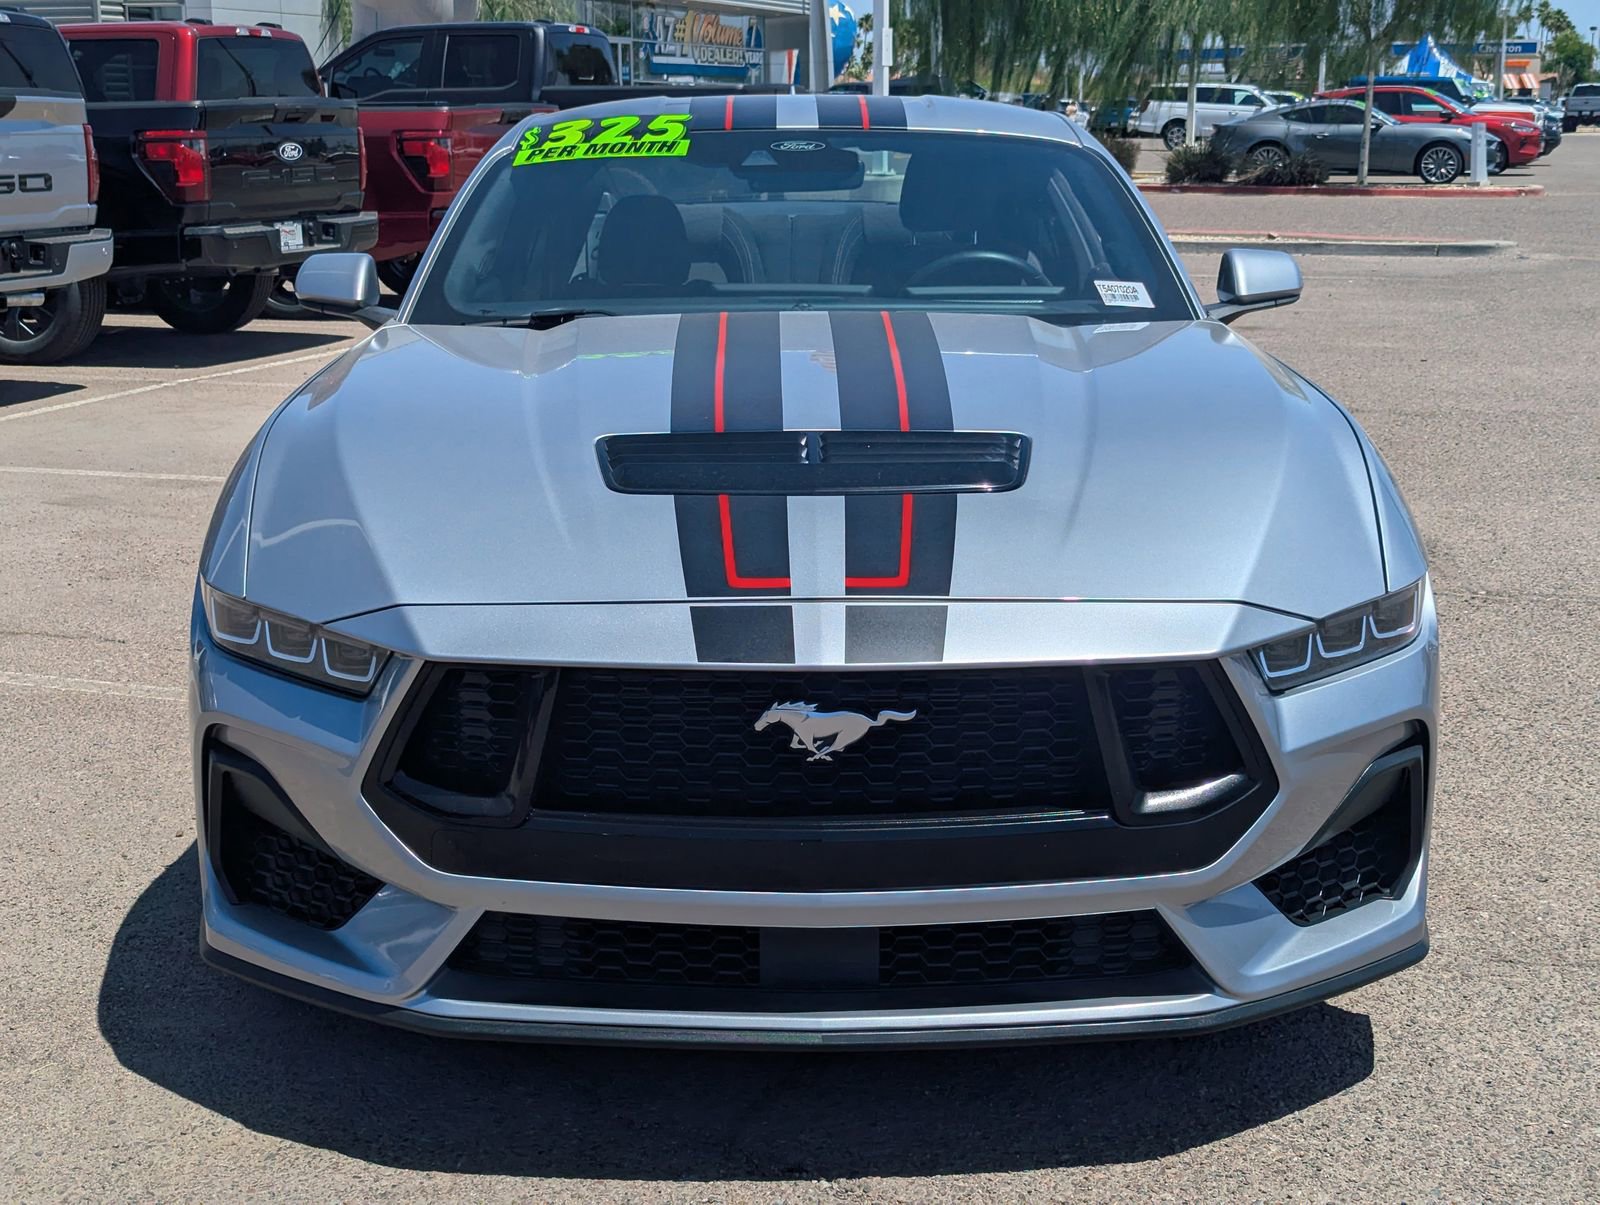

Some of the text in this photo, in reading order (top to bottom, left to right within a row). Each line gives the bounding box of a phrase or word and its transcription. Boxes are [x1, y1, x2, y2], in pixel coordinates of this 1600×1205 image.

[693, 12, 743, 59] Volume
[520, 114, 693, 150] $325
[282, 145, 300, 158] Ford
[525, 140, 680, 162] PER MONTH
[777, 140, 820, 151] Ford
